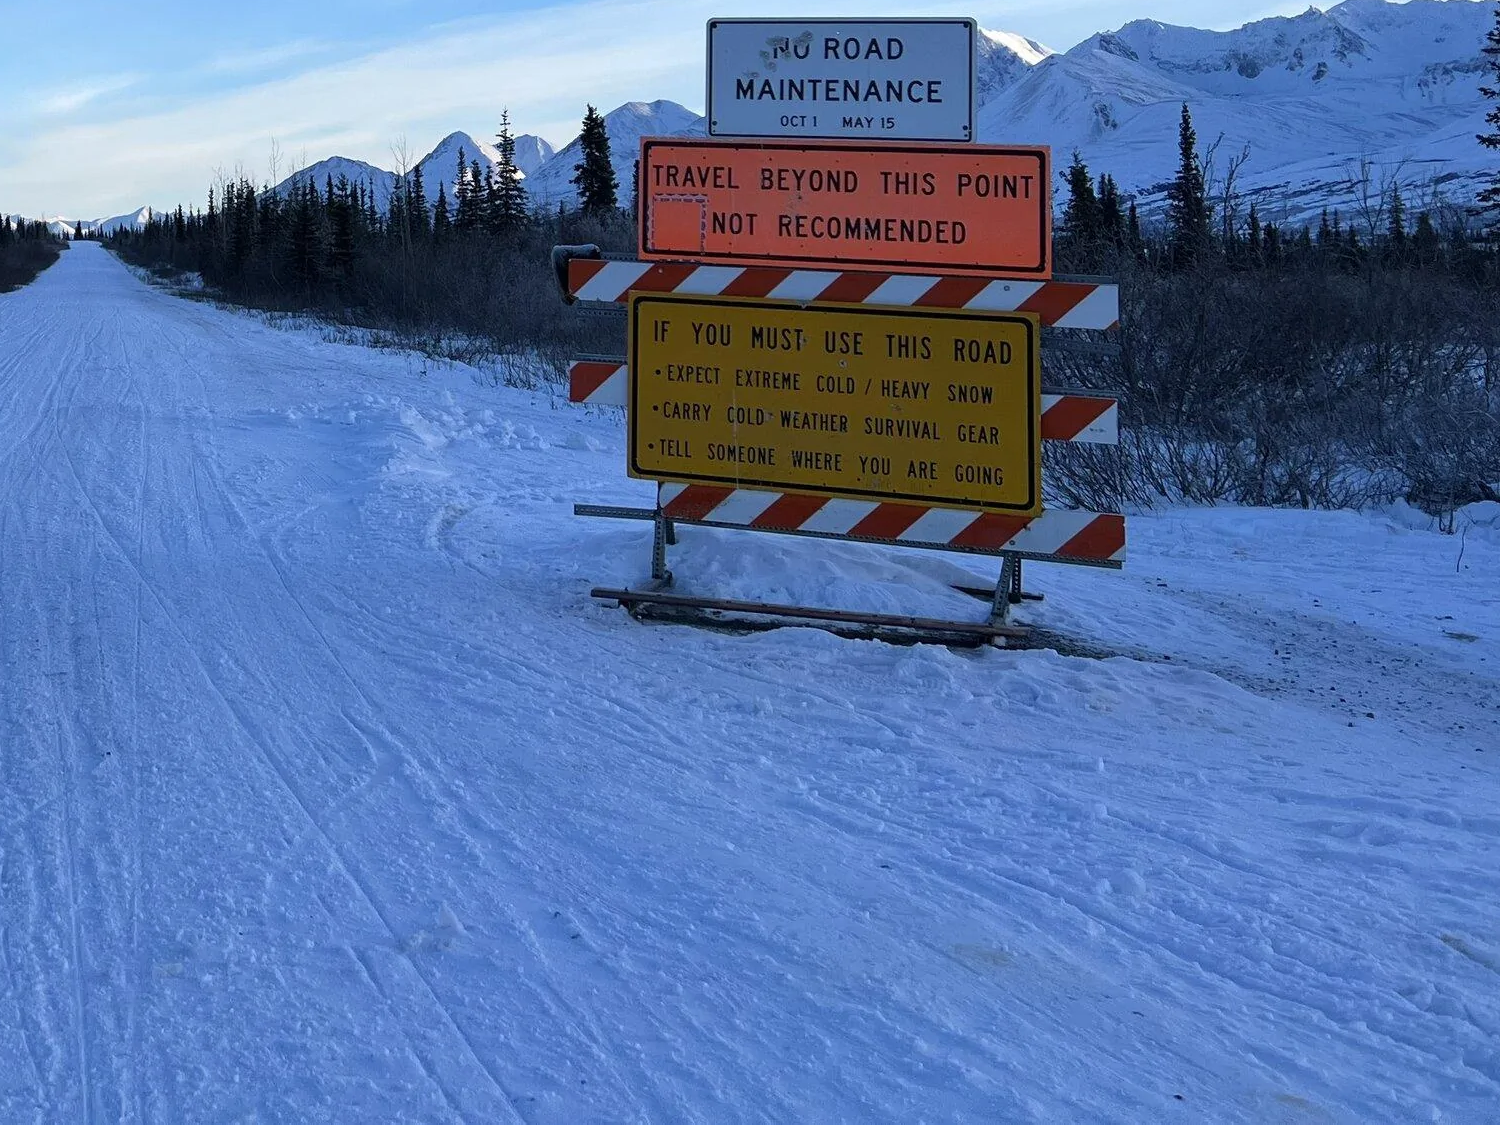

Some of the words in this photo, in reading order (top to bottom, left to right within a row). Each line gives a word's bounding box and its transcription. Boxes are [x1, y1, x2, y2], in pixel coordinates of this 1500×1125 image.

[773, 37, 810, 60] NO
[824, 37, 904, 60] ROAD
[736, 78, 943, 104] MAINTENANCE
[780, 115, 807, 127] OCT
[812, 115, 818, 127] 1
[842, 116, 874, 129] MAY
[880, 117, 896, 130] 15
[652, 164, 740, 189] TRAVEL
[760, 168, 858, 193] BEYOND
[880, 171, 936, 196] THIS
[958, 174, 1034, 199] POINT
[712, 211, 758, 236] NOT
[778, 214, 967, 245] RECOMMENDED
[653, 320, 670, 343] IF
[692, 321, 731, 347] YOU
[751, 326, 804, 351] MUST
[825, 330, 863, 355] USE
[886, 334, 932, 360] THIS
[954, 338, 1012, 365] ROAD
[667, 364, 720, 385] EXPECT
[735, 369, 801, 390] EXTREME
[816, 375, 855, 395] COLD
[864, 378, 872, 396] /
[881, 379, 930, 400] HEAVY
[947, 383, 993, 404] SNOW
[663, 401, 712, 421] CARRY
[726, 406, 765, 426] COLD
[779, 410, 849, 433] WEATHER
[864, 417, 941, 440] SURVIVAL
[957, 424, 999, 445] GEAR
[659, 438, 692, 458] TELL
[707, 442, 776, 465] SOMEONE
[791, 450, 842, 471] WHERE
[859, 455, 891, 475] YOU
[907, 460, 939, 480] ARE
[954, 464, 1004, 486] GOING
